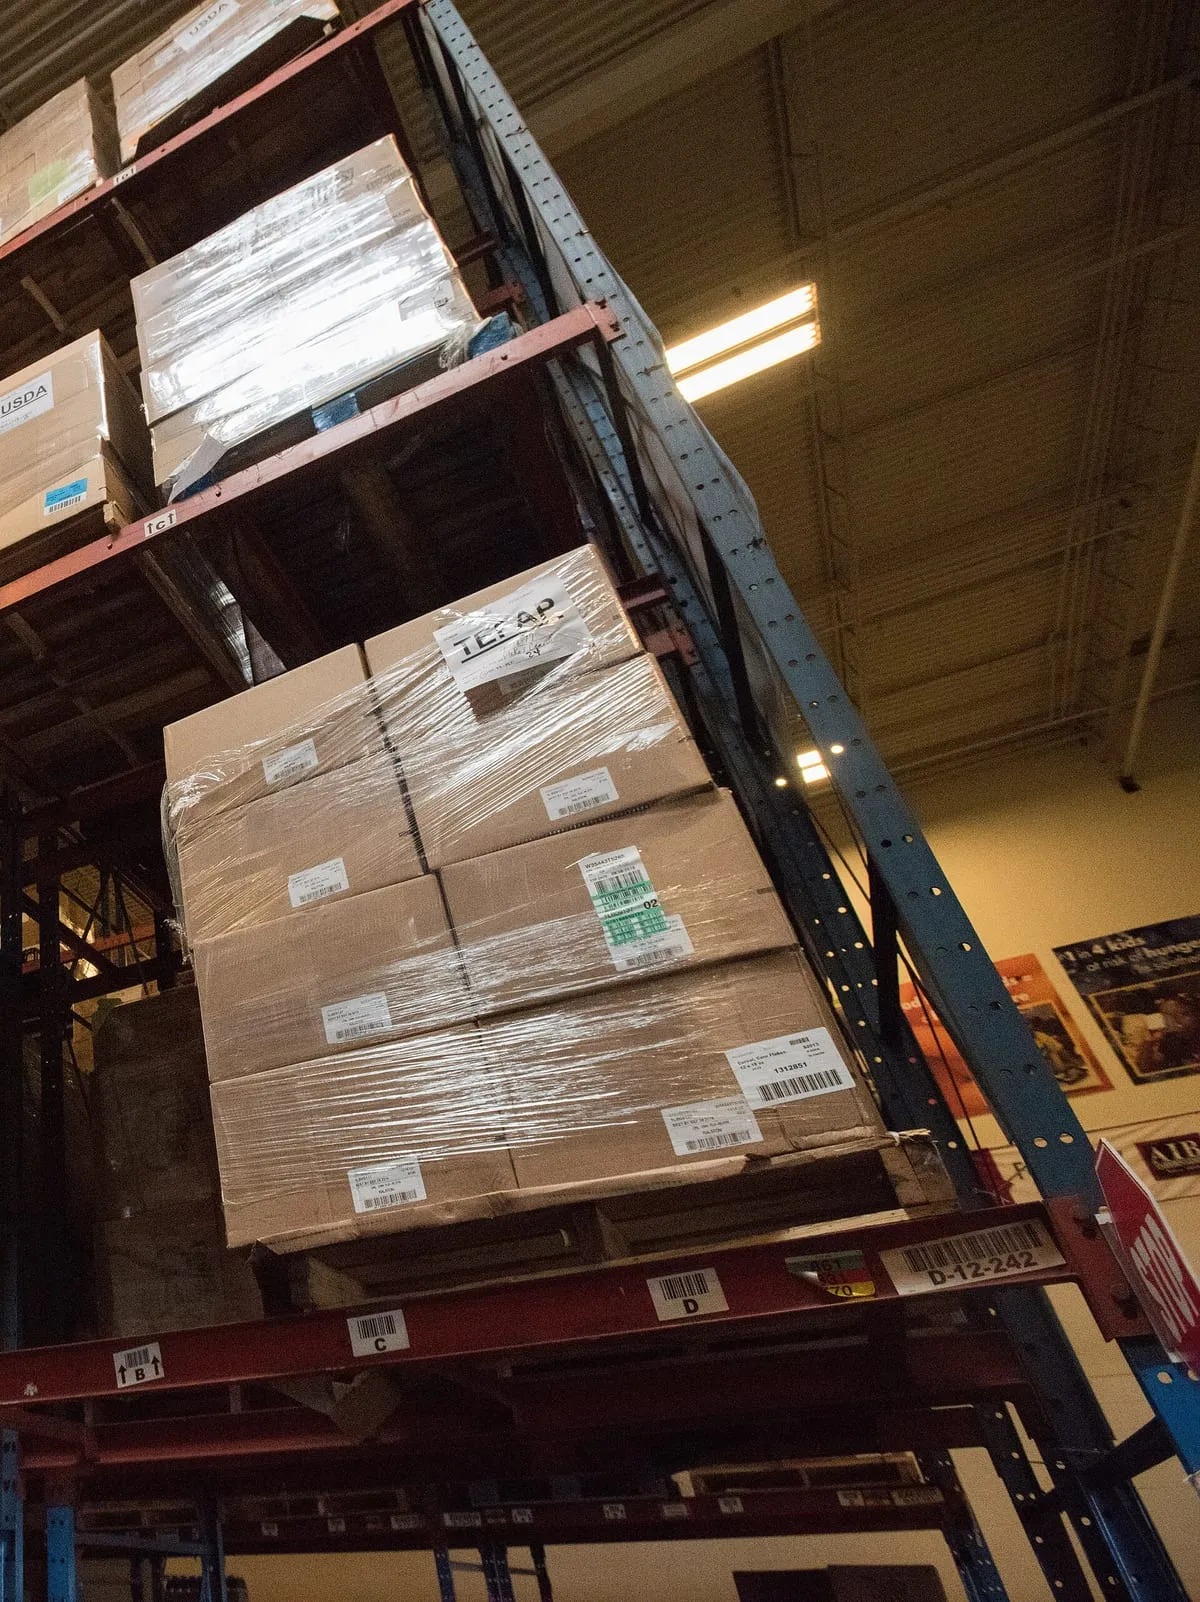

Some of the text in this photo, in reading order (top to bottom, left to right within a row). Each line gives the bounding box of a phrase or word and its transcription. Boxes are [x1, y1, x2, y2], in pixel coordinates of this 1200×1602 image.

[1, 384, 48, 416] USDA
[155, 520, 166, 530] C
[644, 898, 658, 909] 02
[1105, 933, 1146, 951] kids
[774, 1061, 808, 1074] 1312851
[927, 1251, 1038, 1286] D-12-242
[1130, 1212, 1199, 1343] STOP
[682, 1298, 699, 1314] D
[374, 1337, 387, 1351] C
[135, 1368, 145, 1381] B
